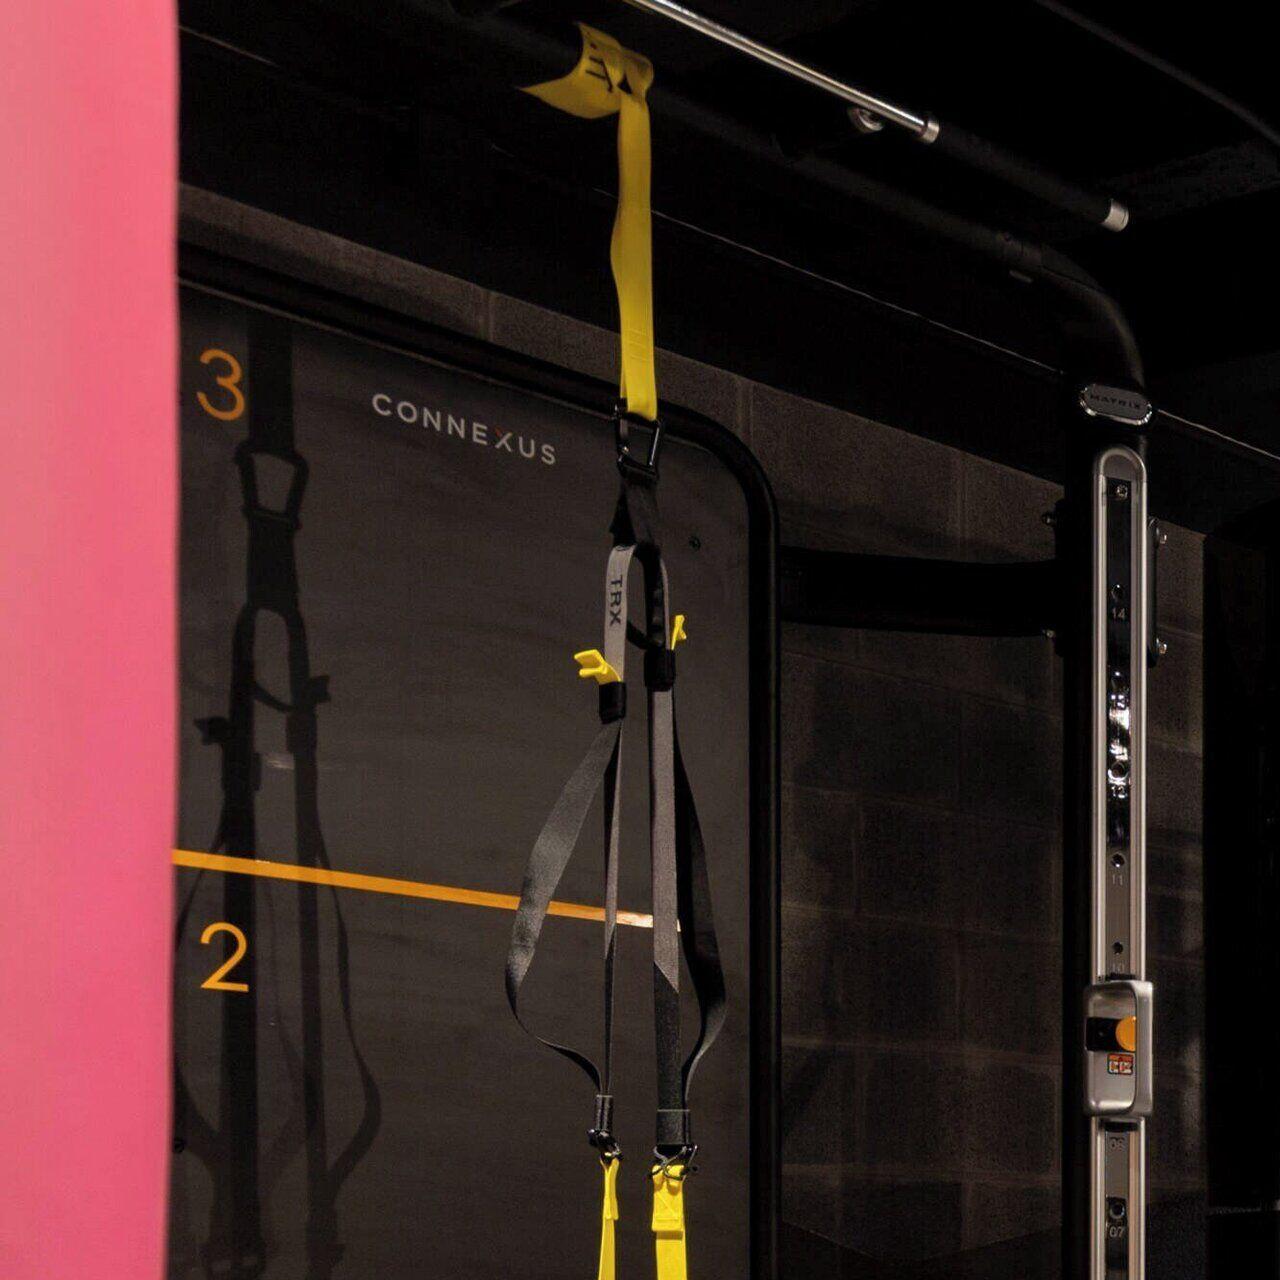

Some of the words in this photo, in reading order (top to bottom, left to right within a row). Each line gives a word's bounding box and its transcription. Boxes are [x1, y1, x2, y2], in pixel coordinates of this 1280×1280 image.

[197, 349, 245, 421] 3
[371, 393, 558, 466] CONNEXUS
[610, 574, 624, 627] TRX
[199, 921, 250, 993] 2
[1109, 1226, 1124, 1238] 07
